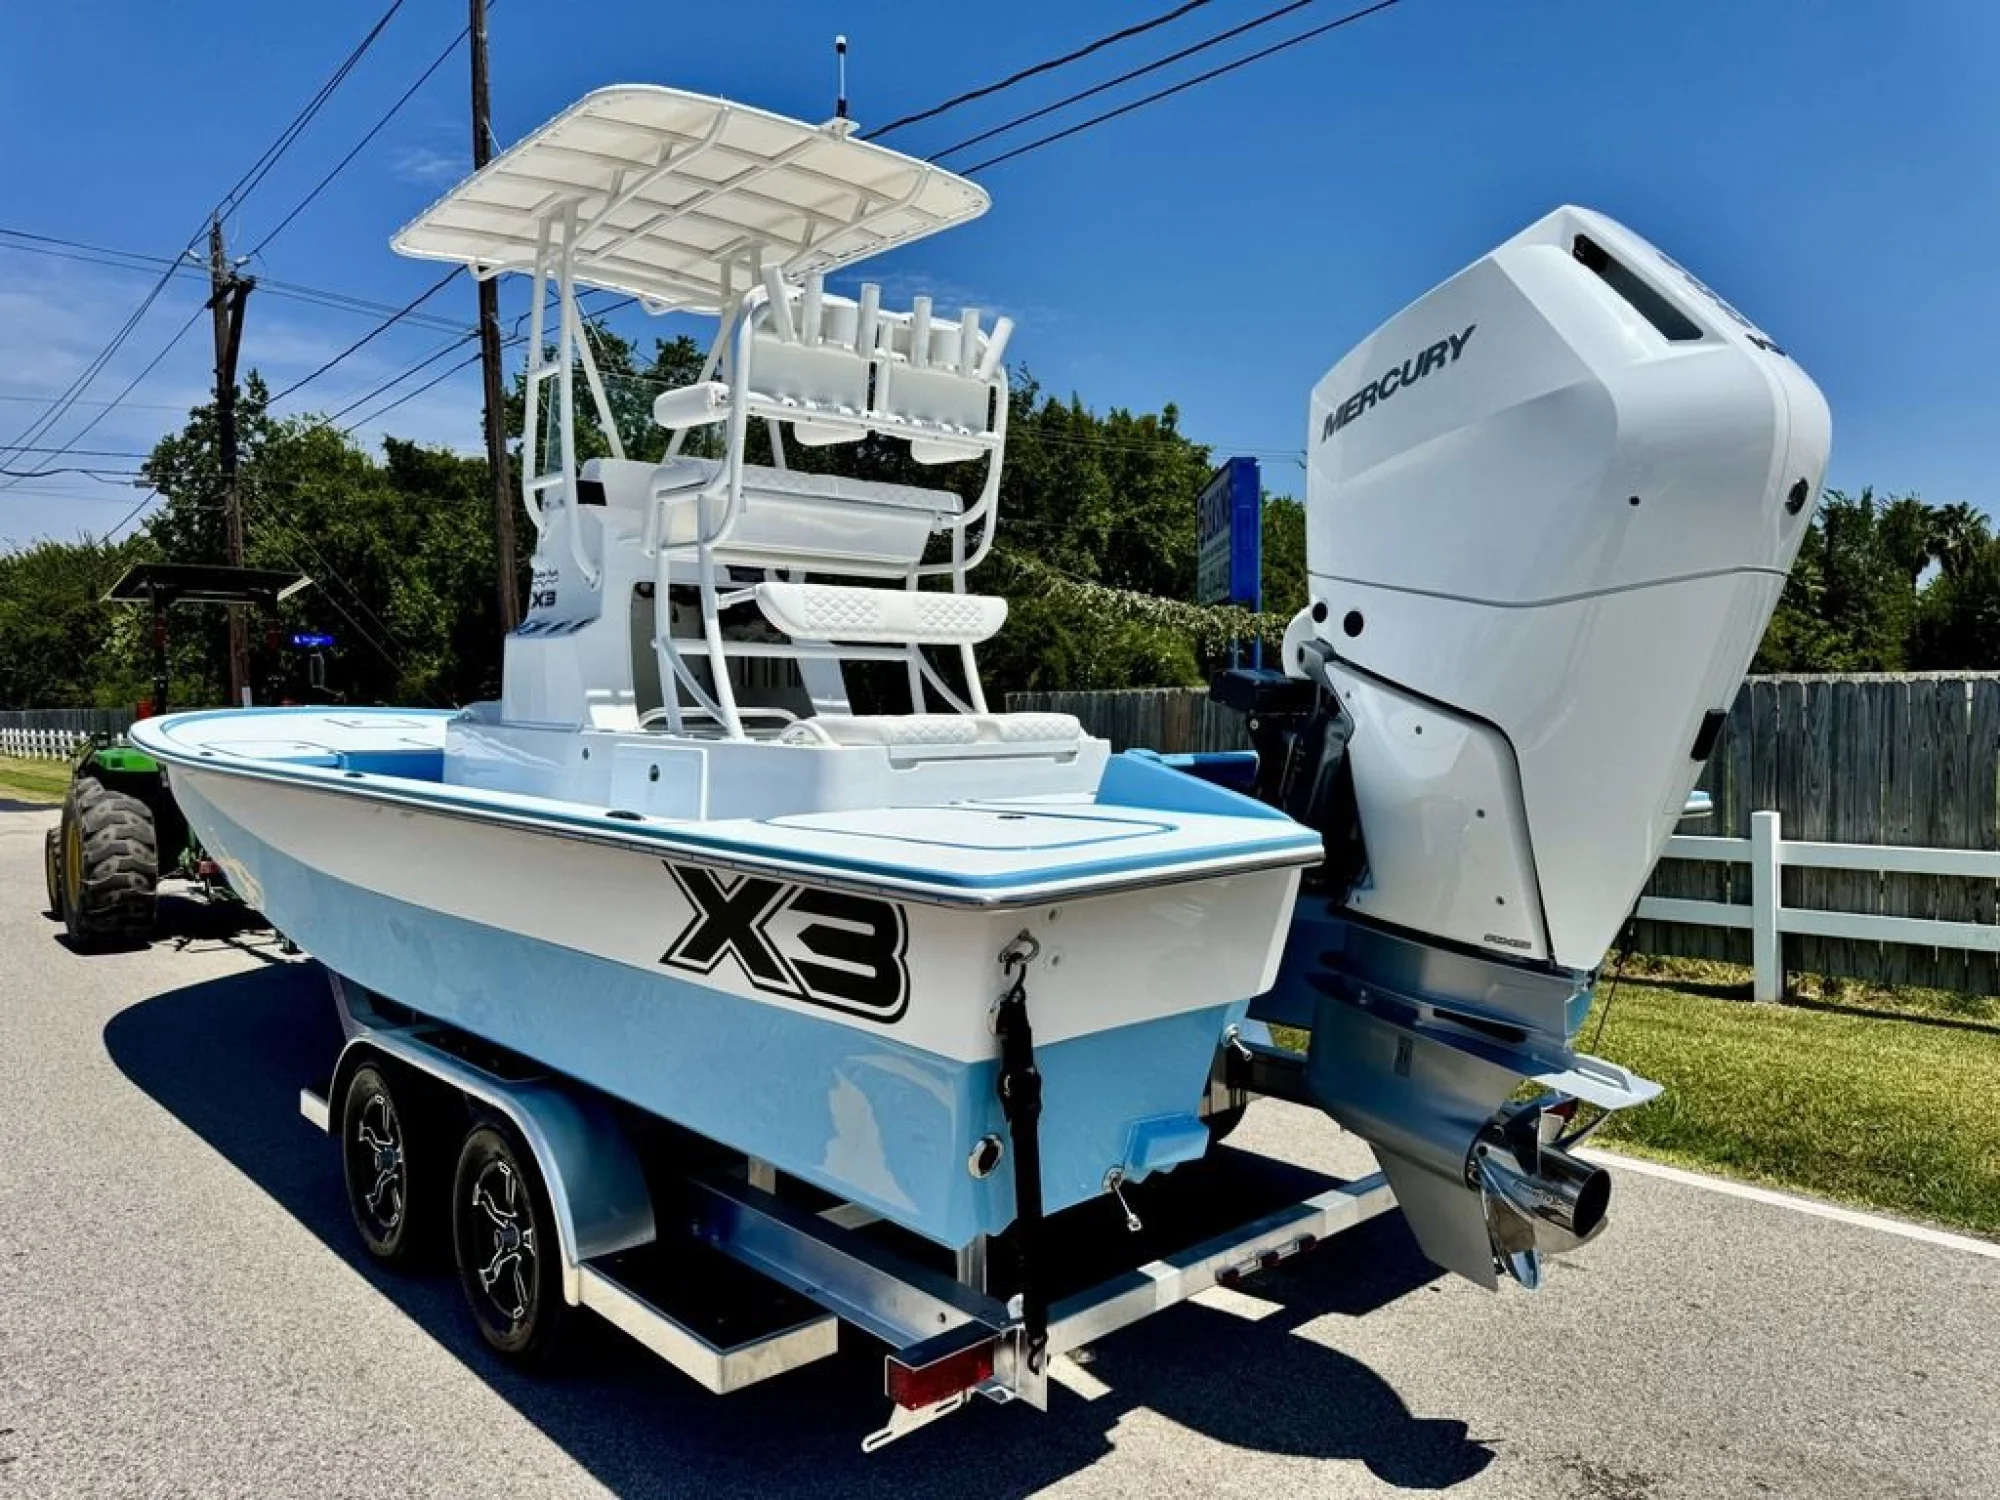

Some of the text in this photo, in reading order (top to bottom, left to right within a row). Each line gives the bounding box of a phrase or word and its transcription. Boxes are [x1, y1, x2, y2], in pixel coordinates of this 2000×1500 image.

[1321, 323, 1476, 443] MERCURY
[532, 590, 556, 609] X3
[658, 859, 911, 1025] X3
